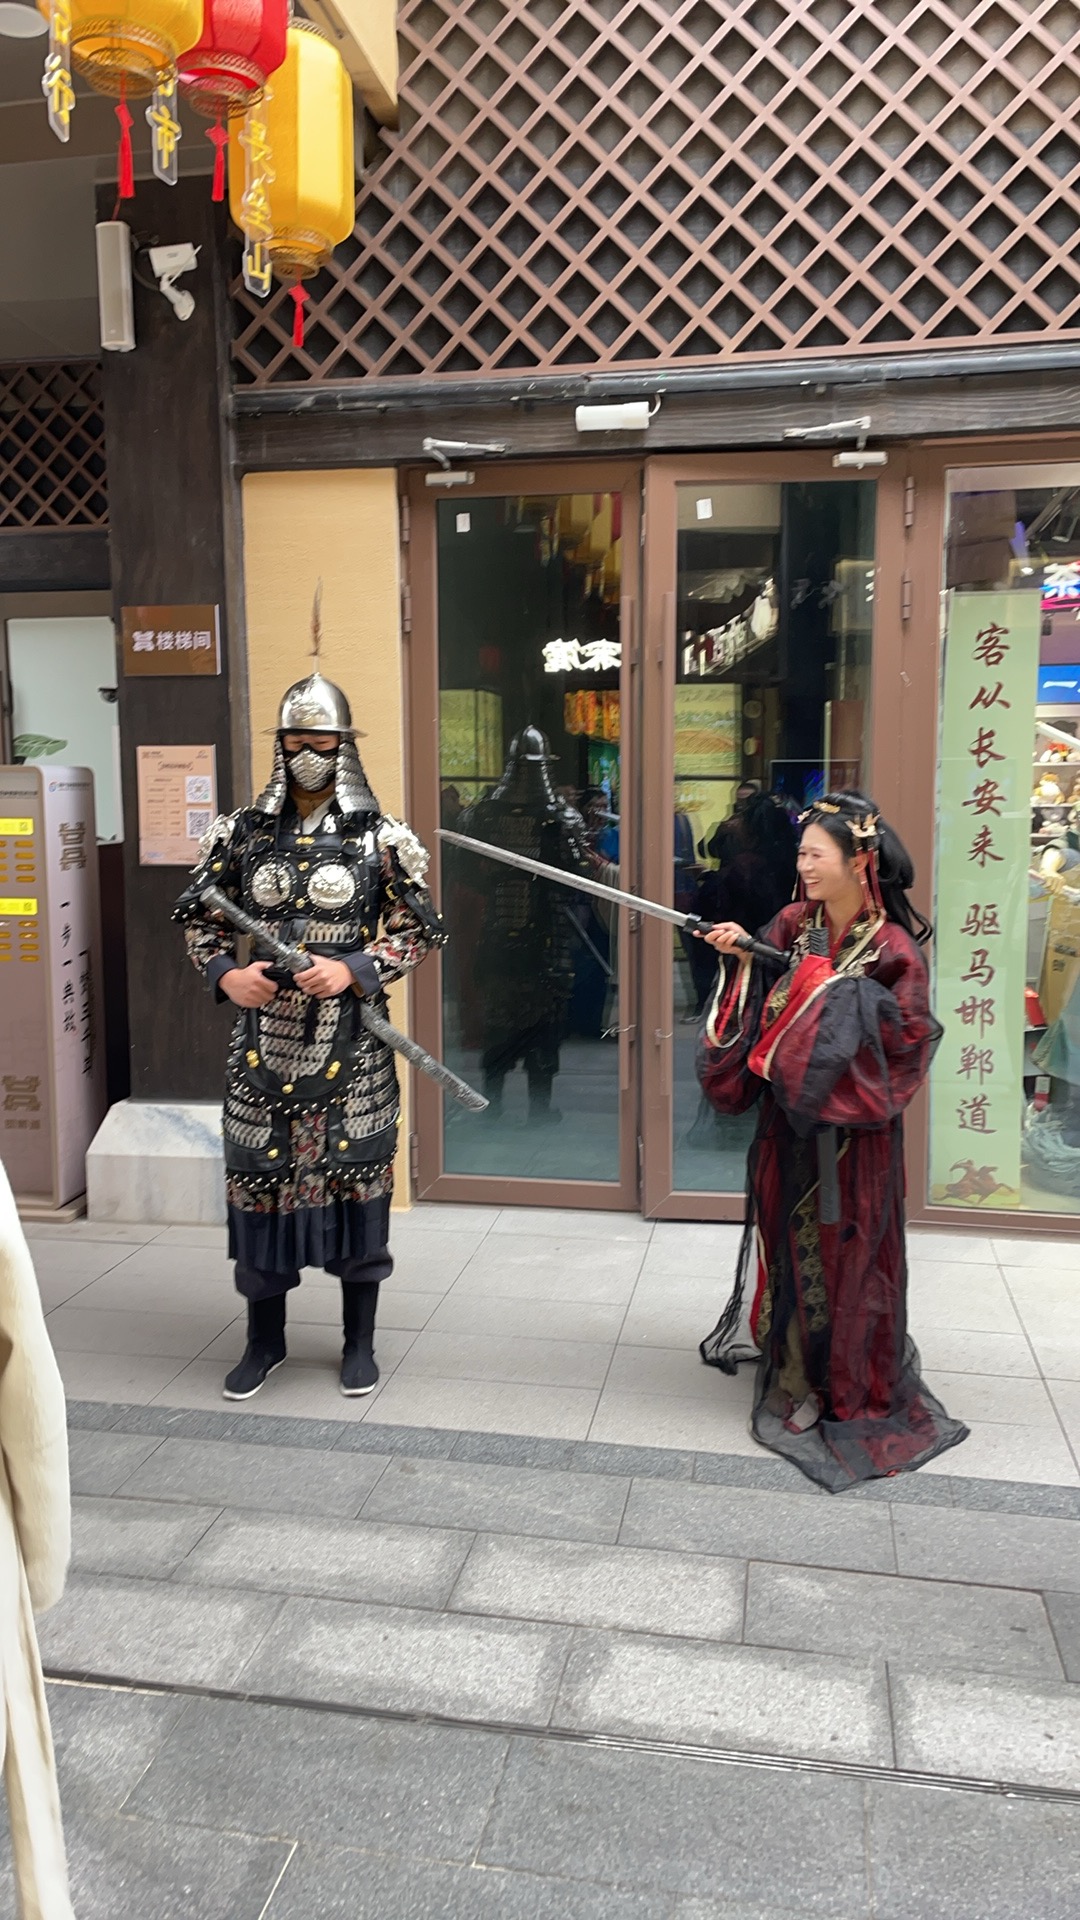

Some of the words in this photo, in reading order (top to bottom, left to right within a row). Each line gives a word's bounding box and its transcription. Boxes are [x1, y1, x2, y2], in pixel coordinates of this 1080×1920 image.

[156, 631, 211, 650] 楼梯间
[962, 622, 1010, 868] 客从长安来
[954, 903, 1002, 1134] 驱马邯郸道
